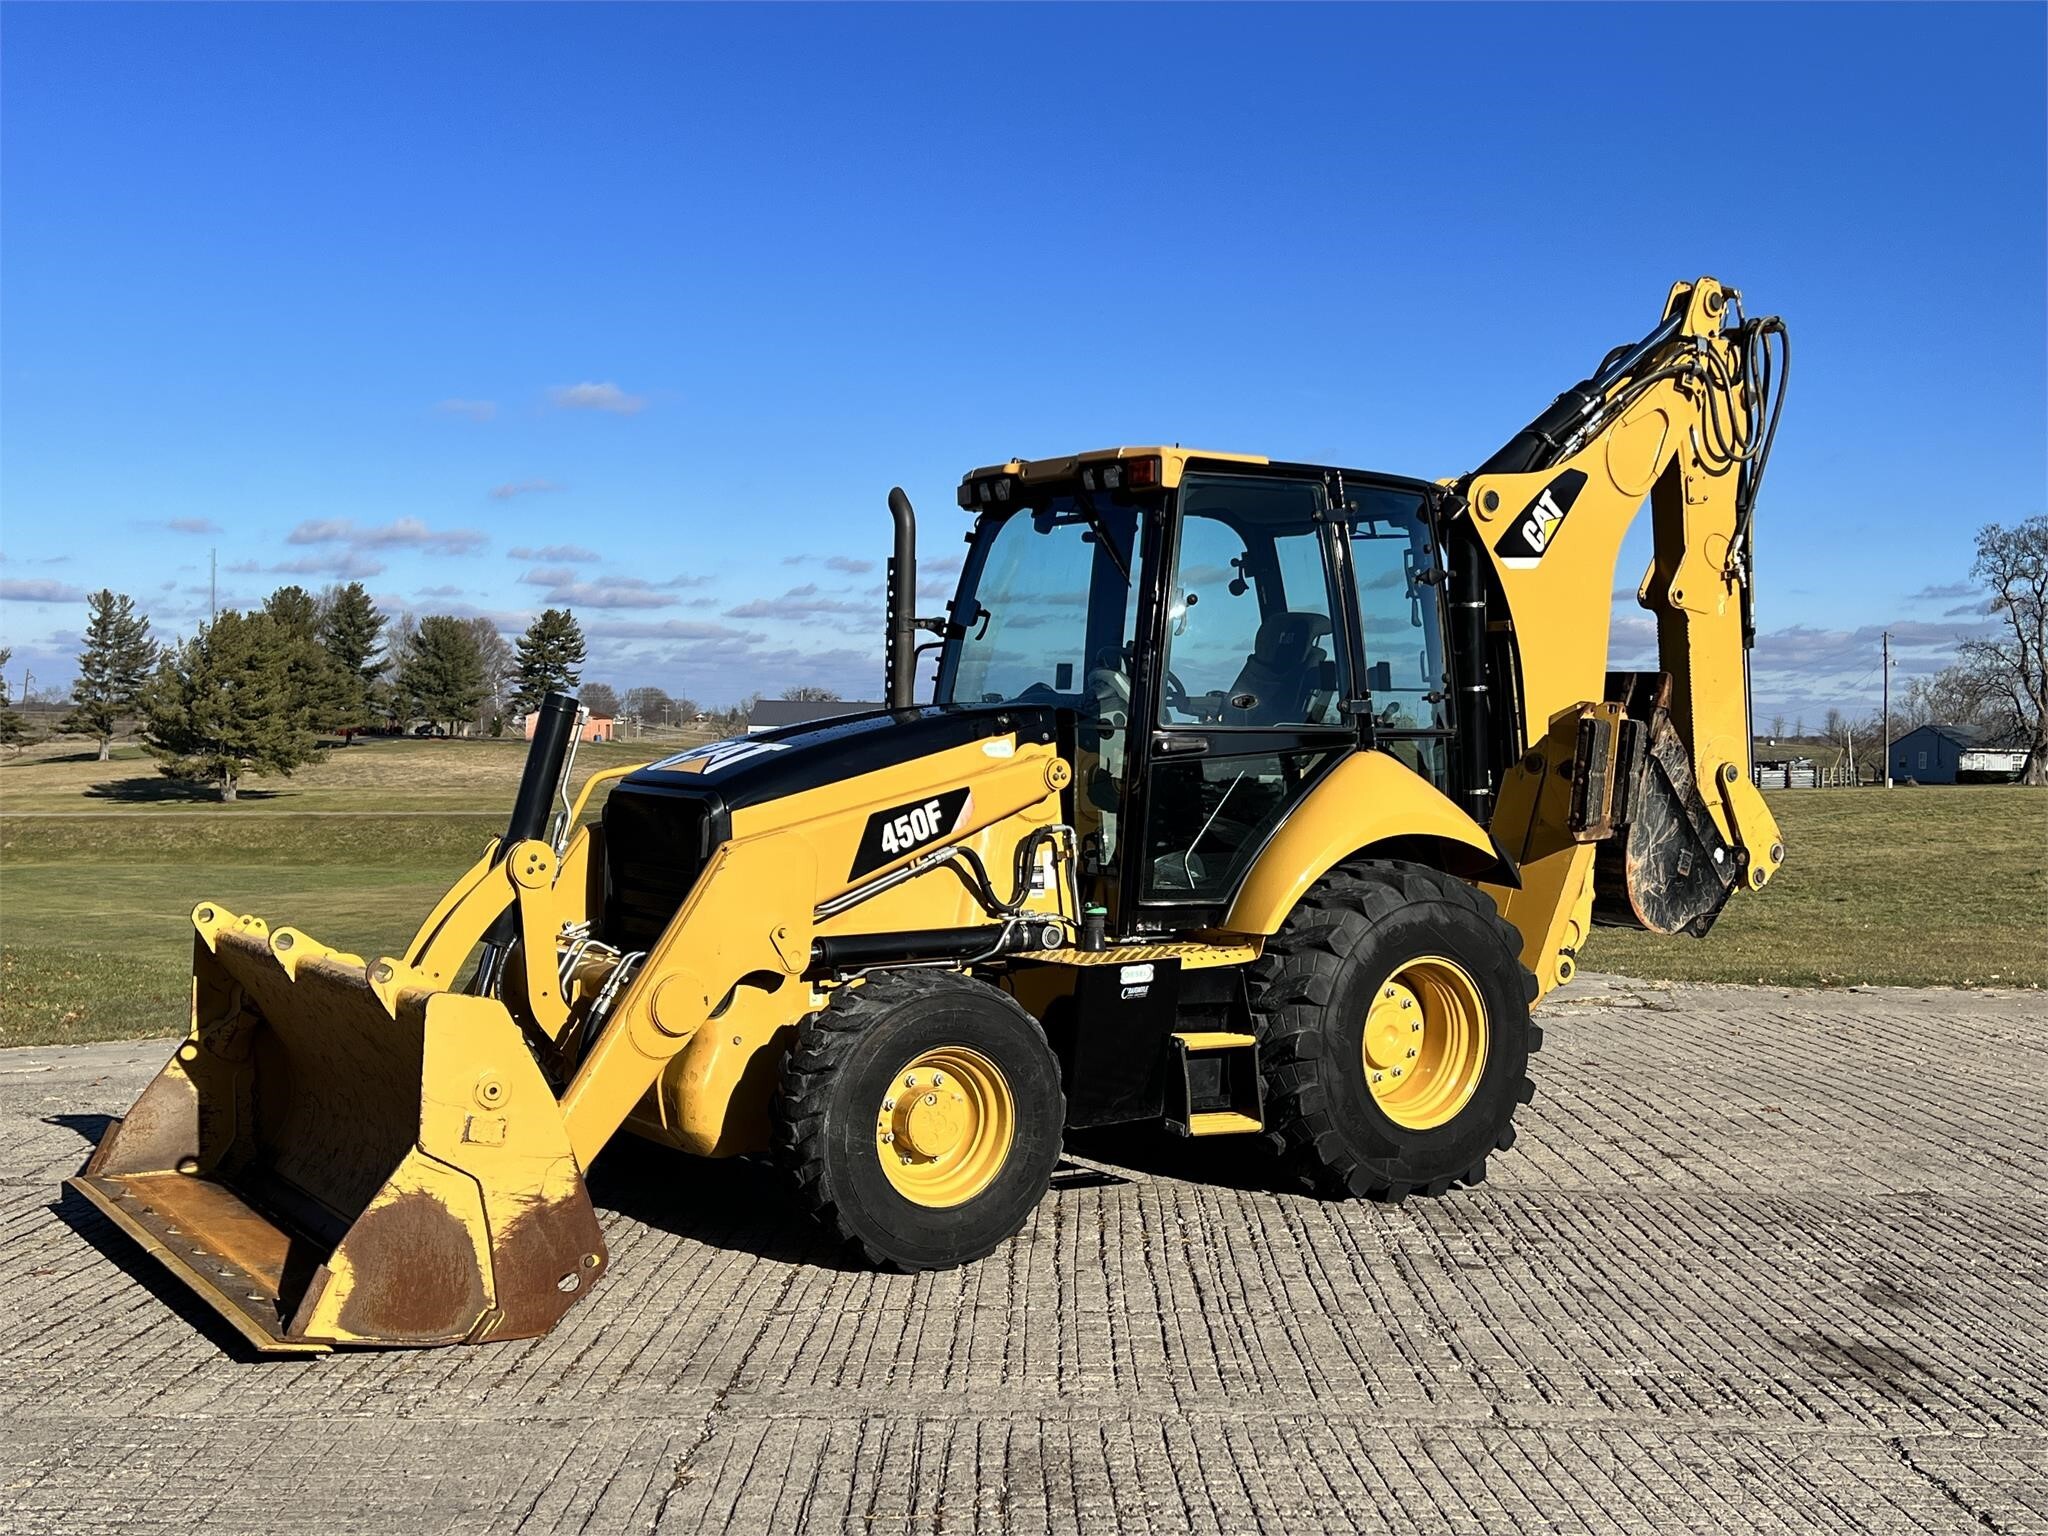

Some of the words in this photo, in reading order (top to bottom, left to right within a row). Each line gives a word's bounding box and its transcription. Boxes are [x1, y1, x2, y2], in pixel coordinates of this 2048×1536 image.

[1522, 488, 1564, 552] CAT
[647, 741, 793, 775] CAT
[881, 799, 942, 854] 450F
